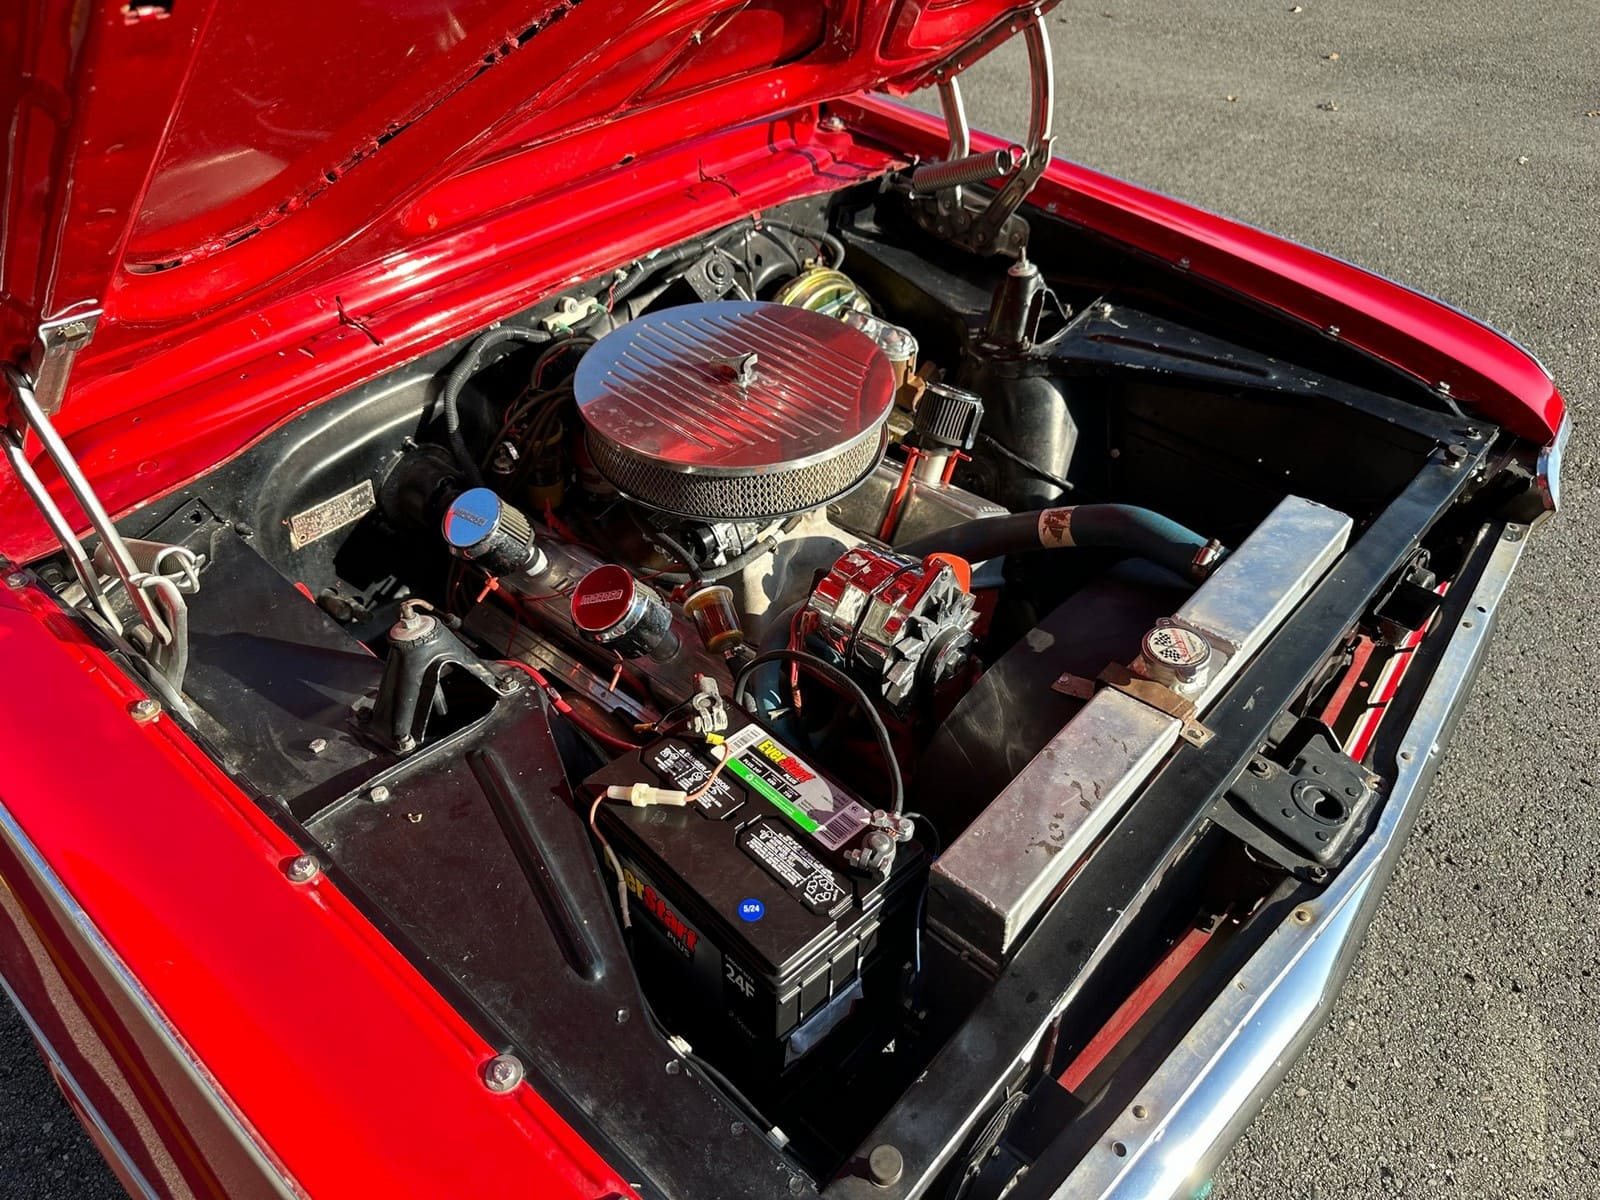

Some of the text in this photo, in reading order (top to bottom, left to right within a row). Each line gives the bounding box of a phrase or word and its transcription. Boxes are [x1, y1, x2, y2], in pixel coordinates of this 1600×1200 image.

[756, 738, 816, 784] EverStart
[743, 904, 760, 913] 5/24
[726, 963, 755, 998] 24F
